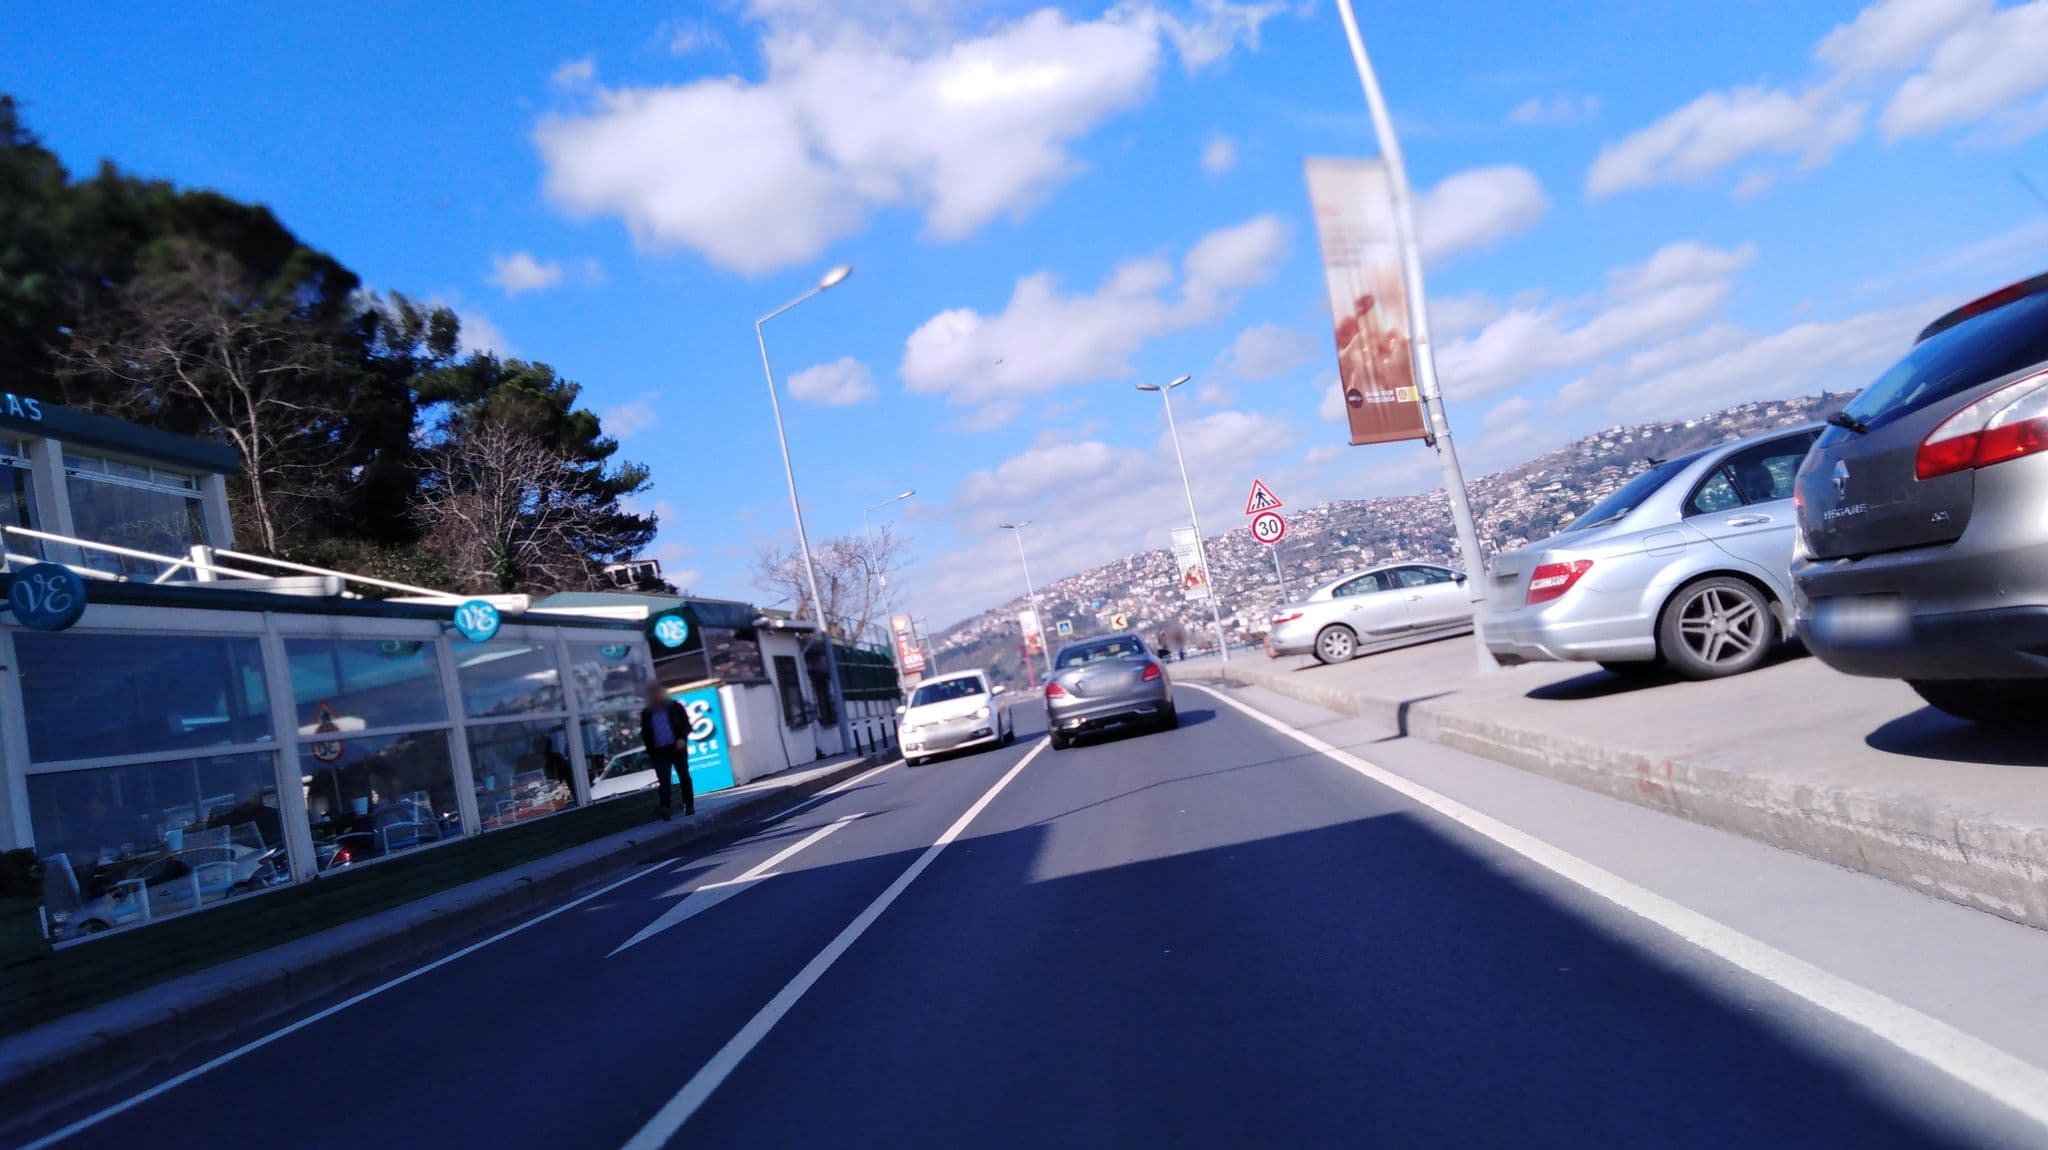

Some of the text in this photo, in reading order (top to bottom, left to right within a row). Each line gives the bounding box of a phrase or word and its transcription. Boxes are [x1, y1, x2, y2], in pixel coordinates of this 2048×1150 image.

[0, 393, 42, 420] AS
[1259, 519, 1278, 536] 30
[13, 573, 73, 613] VE
